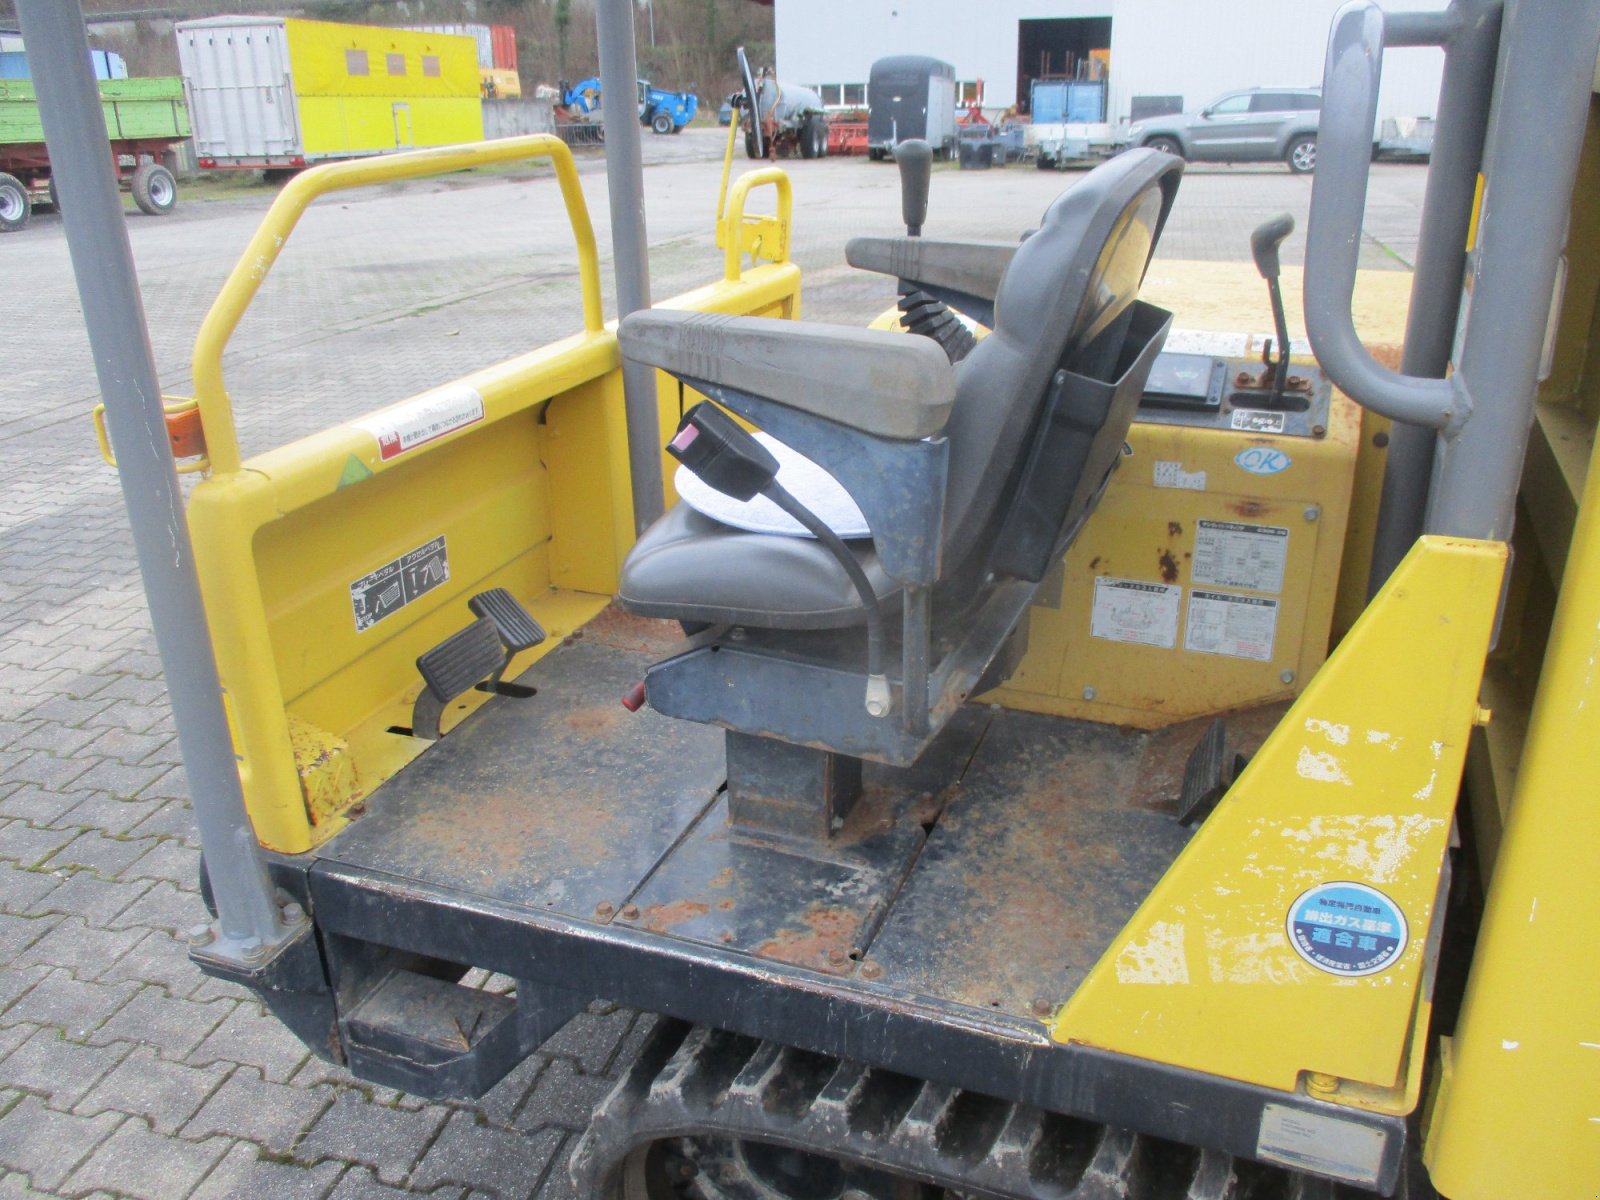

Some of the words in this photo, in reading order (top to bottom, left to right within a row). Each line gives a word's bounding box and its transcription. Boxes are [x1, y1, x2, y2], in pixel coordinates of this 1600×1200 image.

[1244, 450, 1281, 471] OK
[1311, 927, 1378, 951] 適合車
